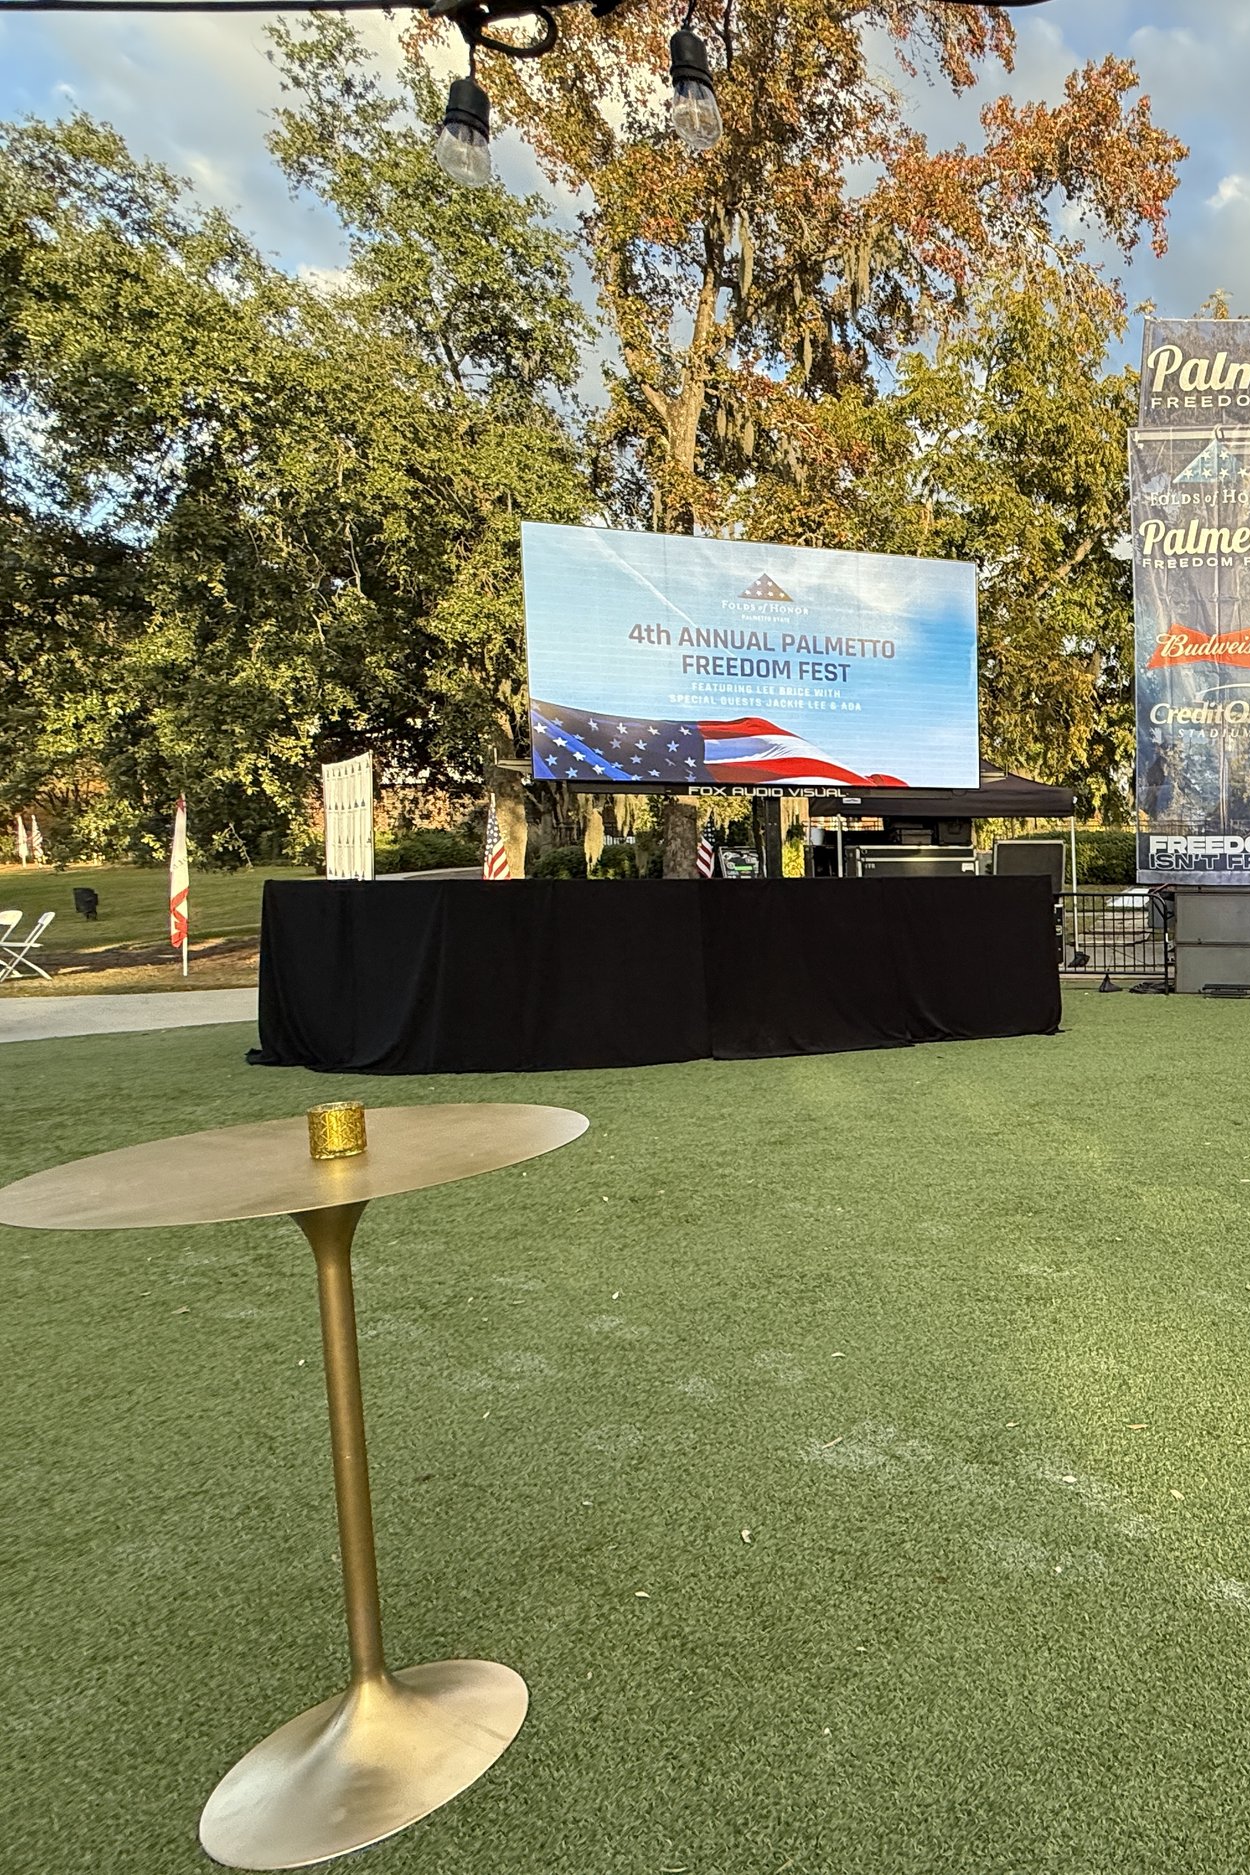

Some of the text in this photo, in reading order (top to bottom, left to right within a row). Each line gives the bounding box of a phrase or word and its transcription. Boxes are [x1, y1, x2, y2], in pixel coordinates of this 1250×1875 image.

[1151, 491, 1200, 506] FOLDS
[1205, 490, 1218, 507] of
[1142, 556, 1233, 569] FREEDOM
[721, 600, 809, 615] FOLDS of HONOR
[628, 623, 896, 660] 4th ANNUAL PALMETTO
[682, 654, 851, 683] FREEDOM FEST
[692, 682, 841, 699] FEATURING LEE BRICE WITH
[668, 694, 716, 706] SPECIAL
[720, 696, 762, 707] GUESTS
[766, 698, 804, 709] JACKIE
[808, 700, 826, 710] LEE
[829, 701, 837, 711] &
[688, 786, 847, 798] FOX AUDIO VISUAL
[1149, 853, 1220, 870] ISN'T
